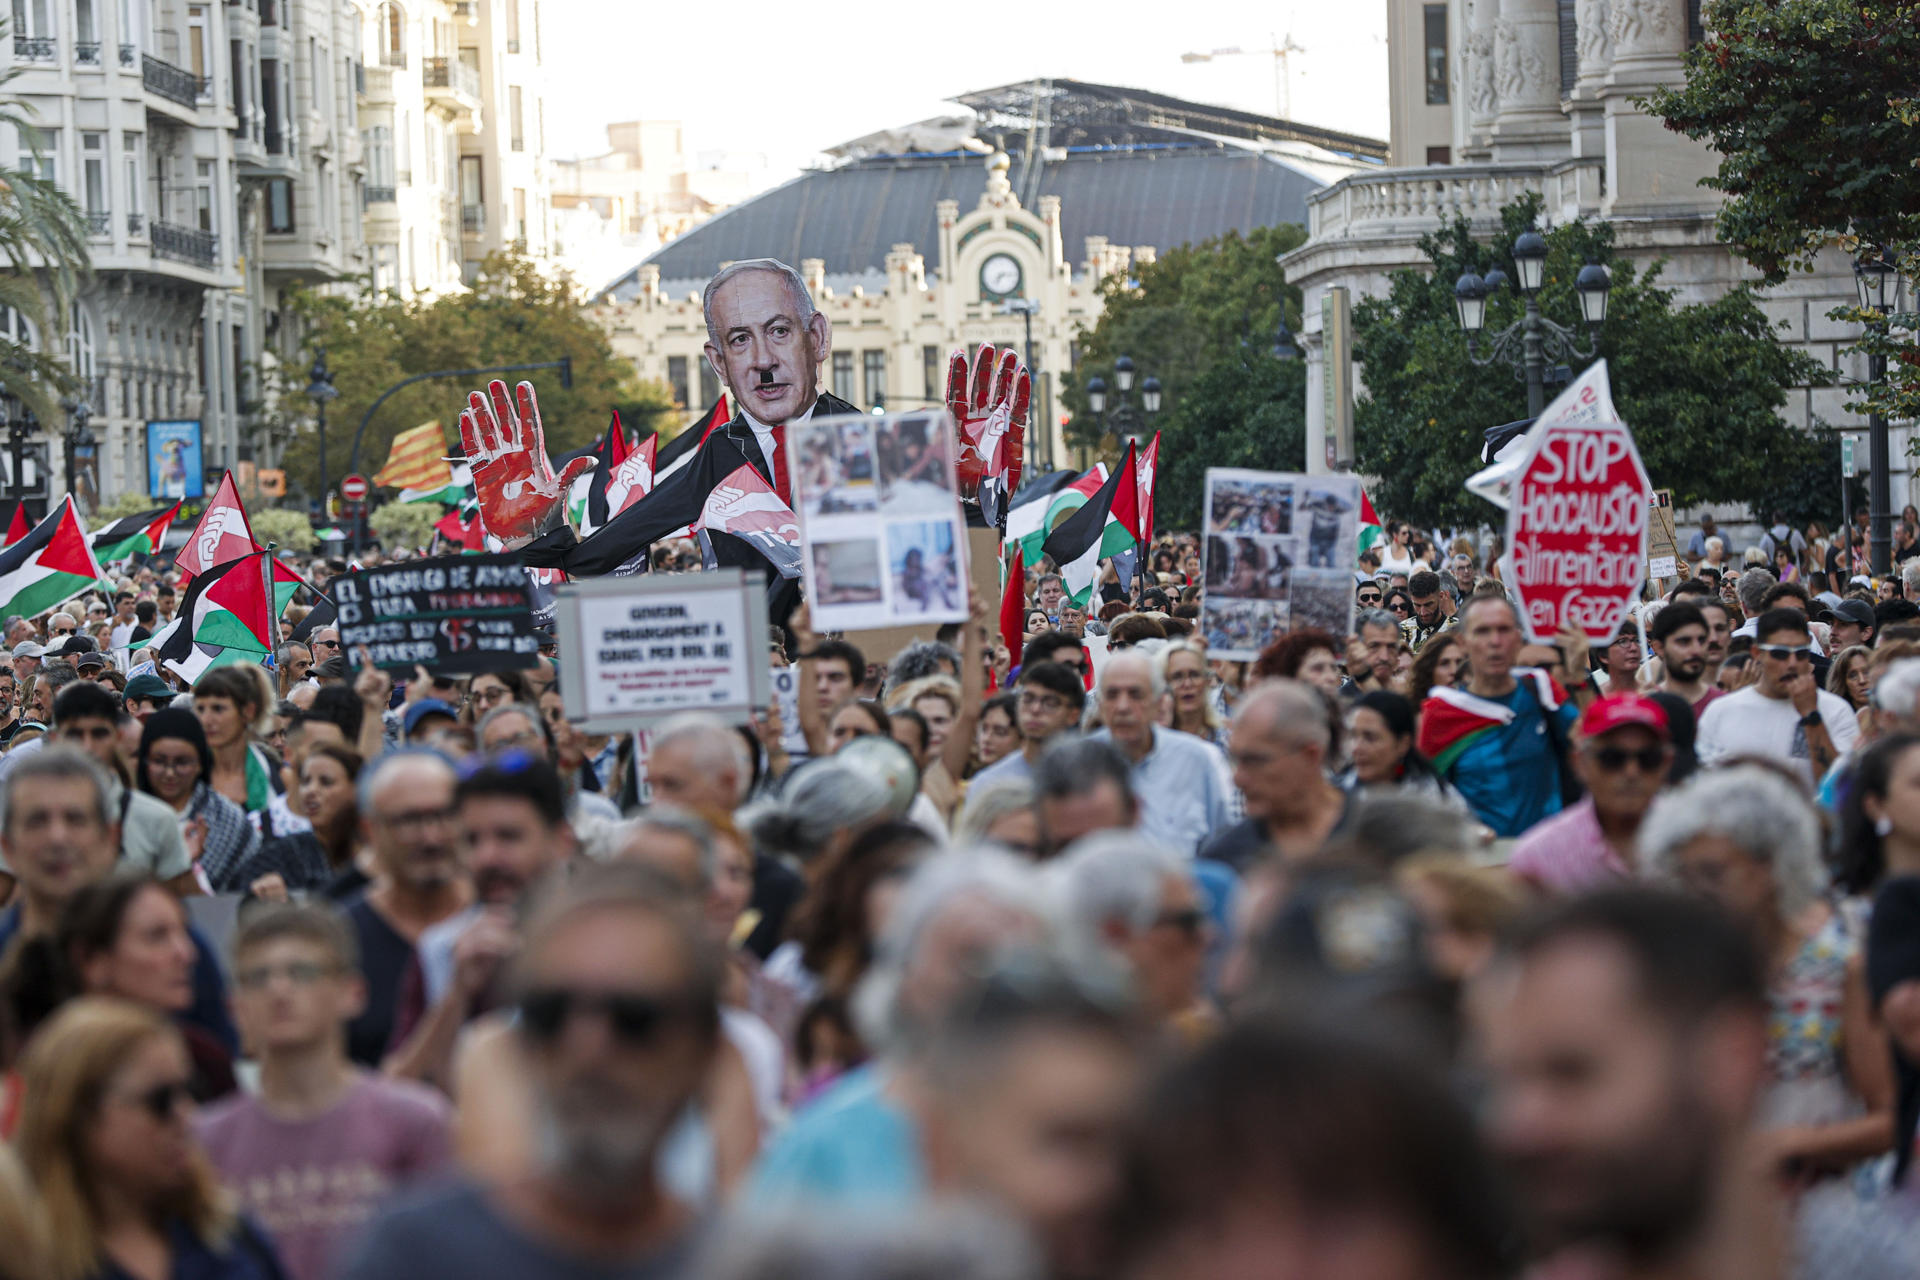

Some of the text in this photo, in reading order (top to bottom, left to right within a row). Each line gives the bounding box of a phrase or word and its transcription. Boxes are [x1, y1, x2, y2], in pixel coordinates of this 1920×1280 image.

[1533, 431, 1628, 484] STOP
[1514, 535, 1641, 588] alimentario
[335, 579, 362, 603] EL
[1528, 588, 1626, 628] en Gaza
